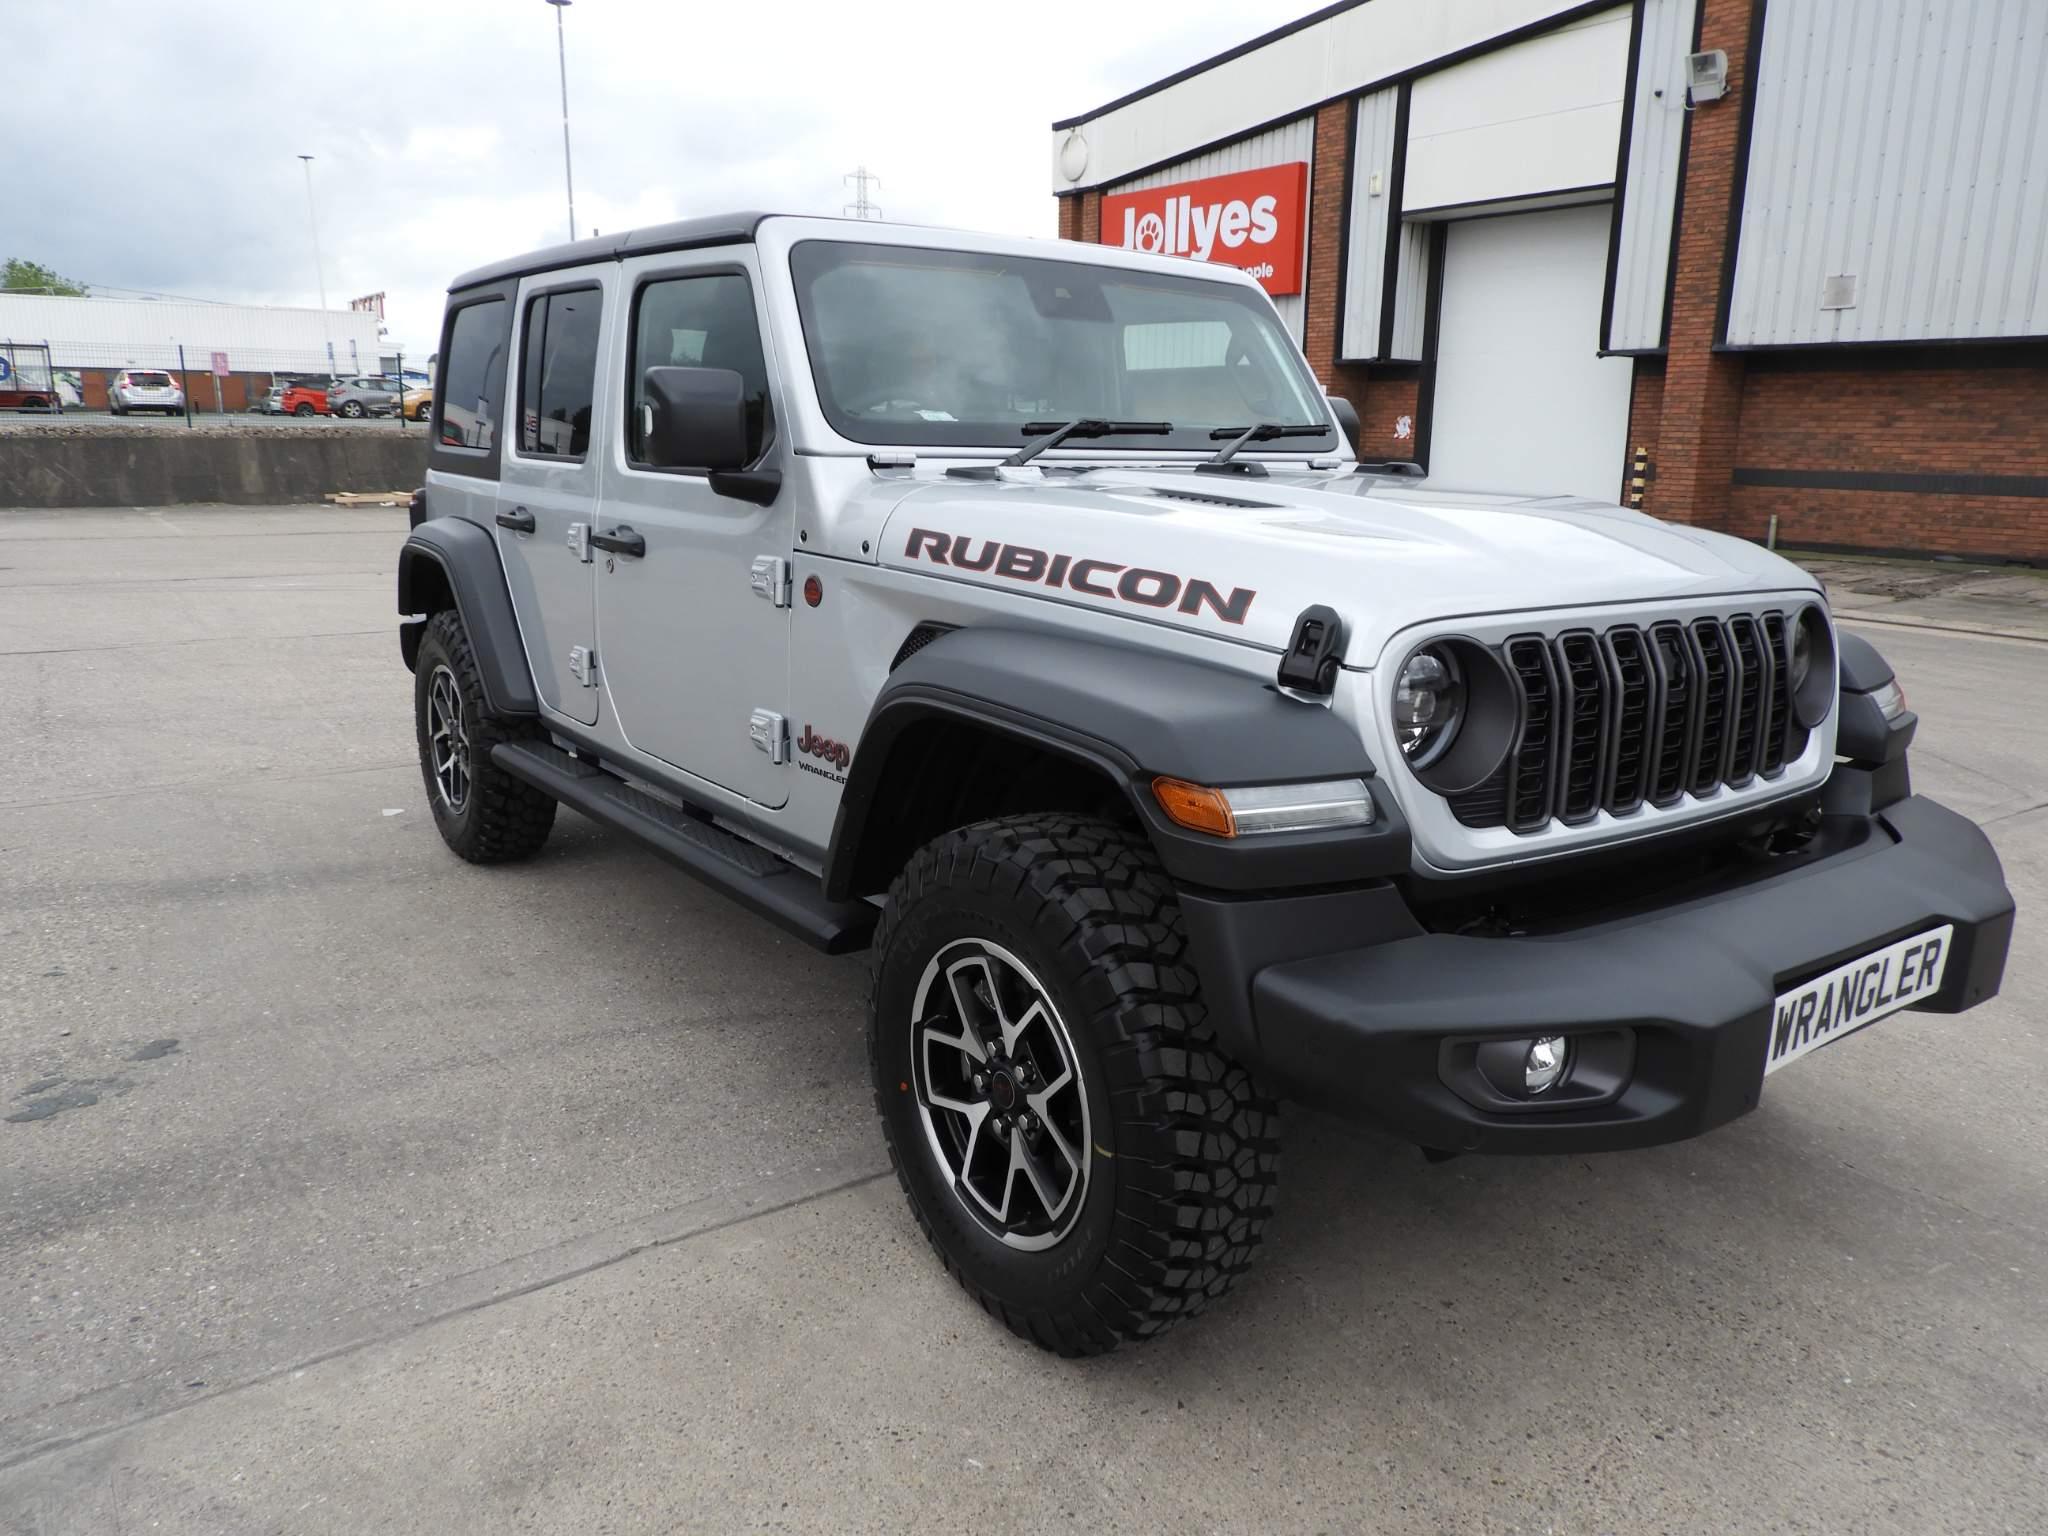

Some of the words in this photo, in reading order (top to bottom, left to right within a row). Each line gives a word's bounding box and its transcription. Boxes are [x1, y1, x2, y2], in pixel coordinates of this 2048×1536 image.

[1122, 195, 1278, 261] Jollyes
[1243, 262, 1274, 278] ople
[904, 527, 1256, 625] RUBICON
[797, 723, 850, 772] Jeep
[1771, 938, 1942, 1062] WRANGLER
